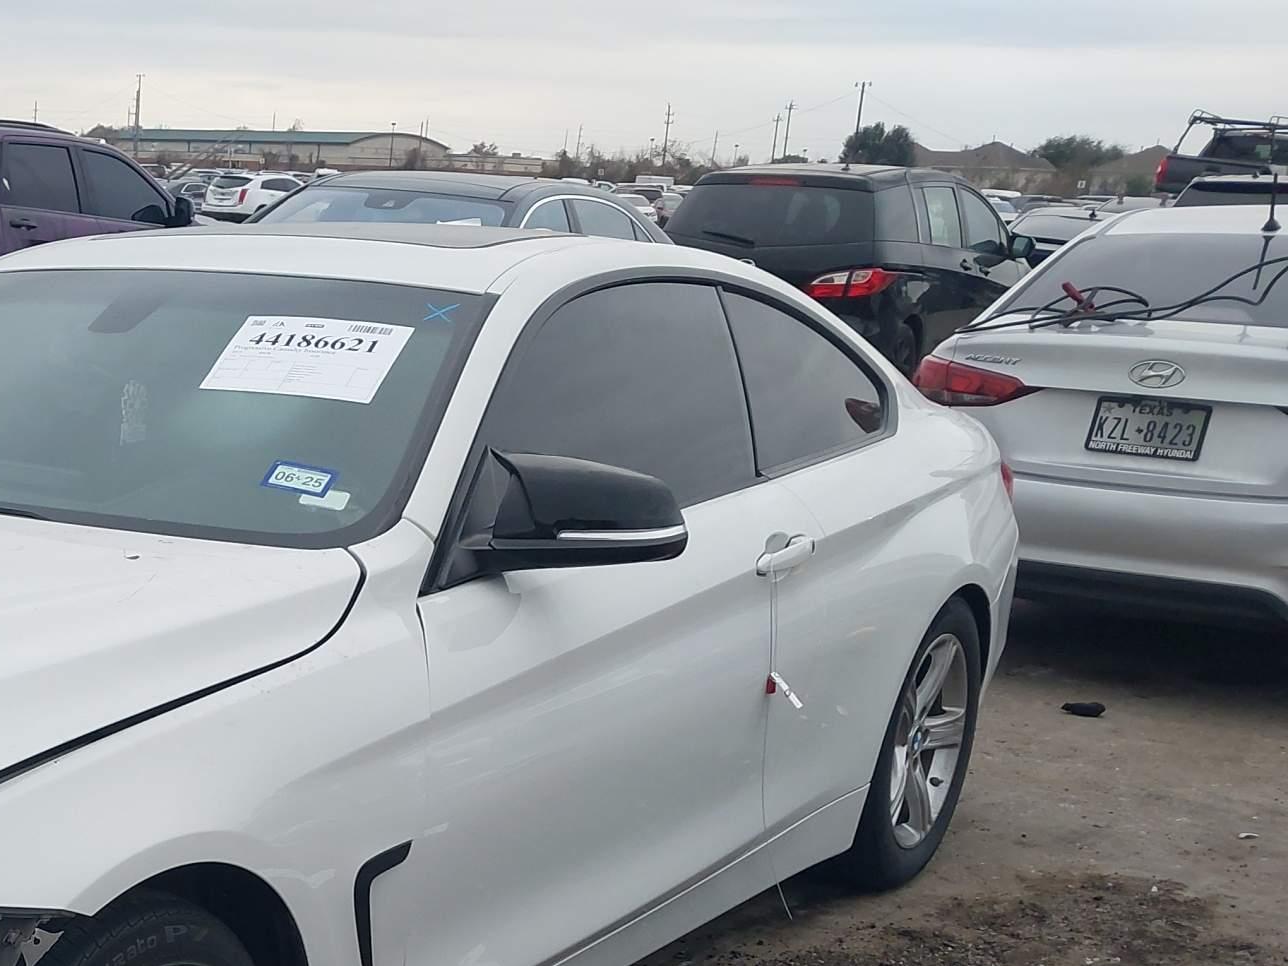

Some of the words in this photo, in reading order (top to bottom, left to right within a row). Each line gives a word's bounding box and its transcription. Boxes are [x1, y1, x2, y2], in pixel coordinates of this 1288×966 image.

[249, 331, 380, 354] 44186621
[965, 352, 1023, 366] ACCENT
[1132, 401, 1174, 417] TEXAS
[1088, 440, 1117, 452] NORTH
[1117, 443, 1156, 456] FREEWAY
[1156, 447, 1195, 460] HYUNDAI
[274, 470, 296, 483] 06
[302, 475, 326, 488] 25
